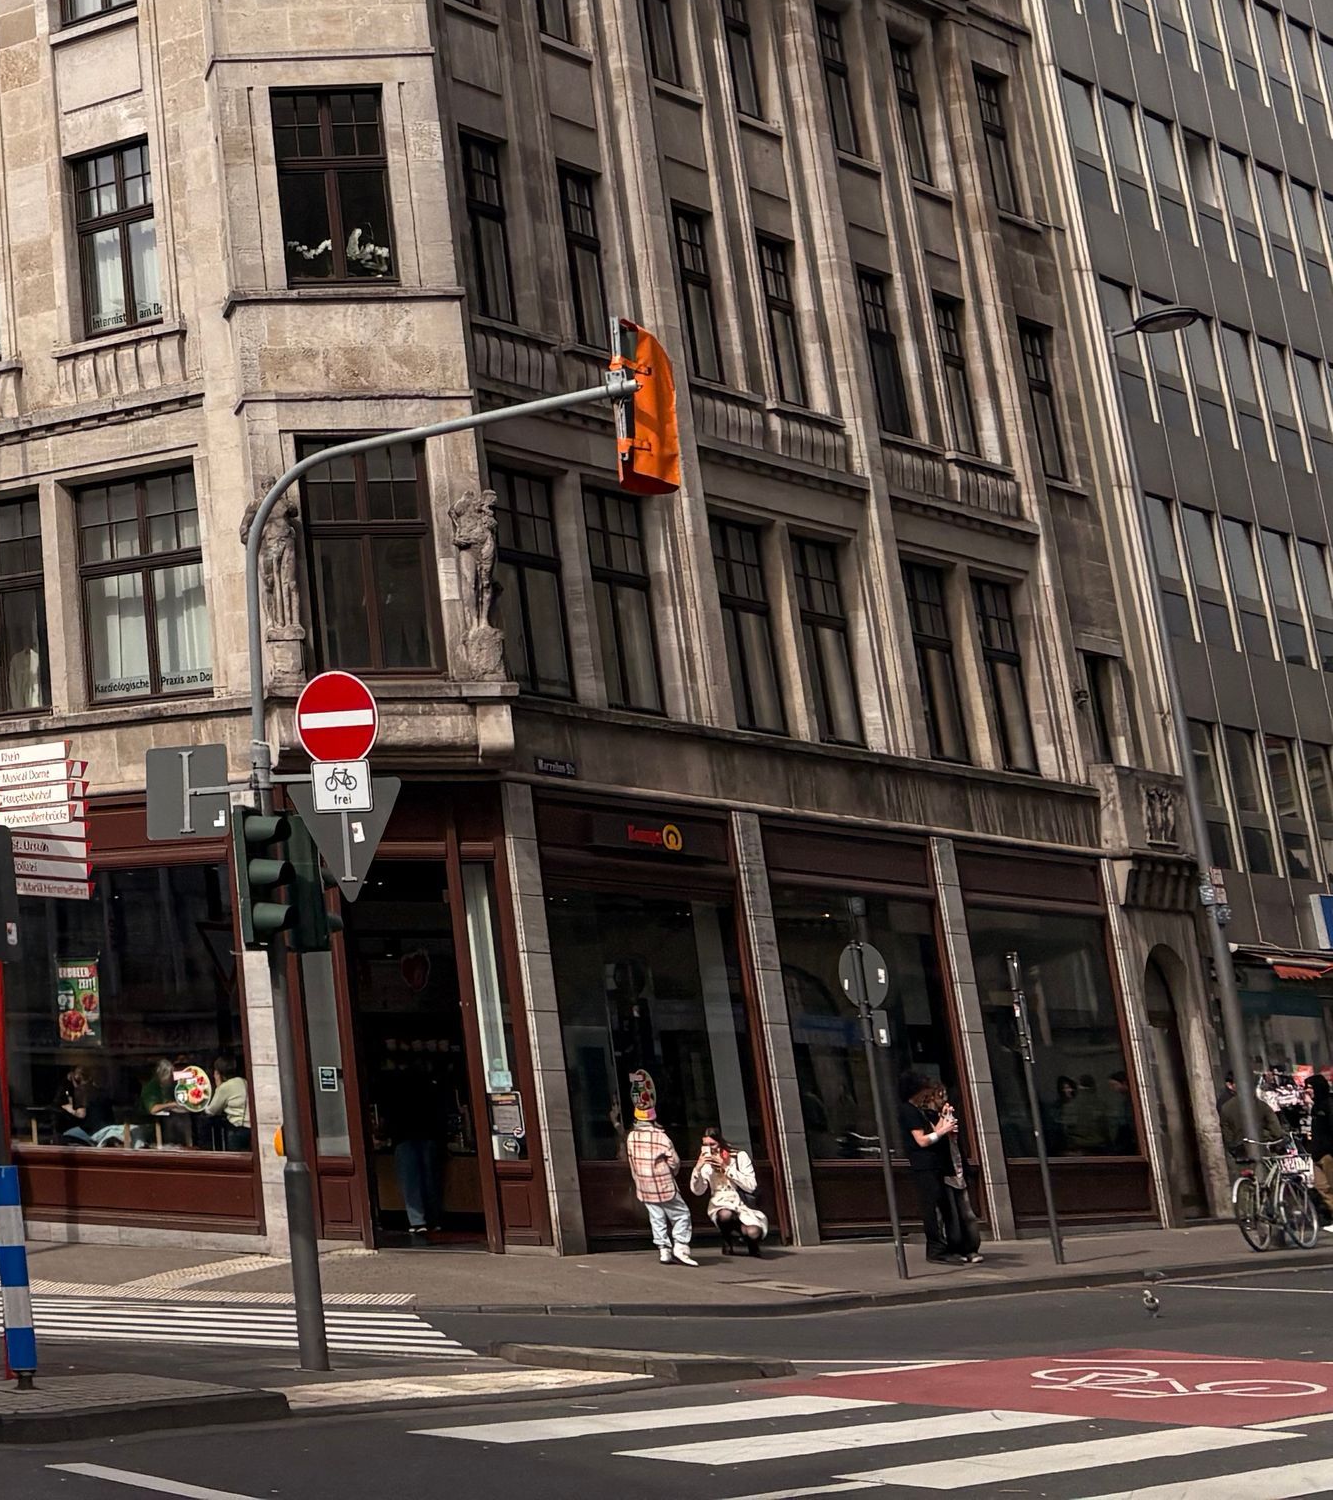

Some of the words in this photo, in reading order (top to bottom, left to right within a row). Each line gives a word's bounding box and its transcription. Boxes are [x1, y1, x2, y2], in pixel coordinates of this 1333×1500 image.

[94, 679, 149, 694] Kardiologische
[161, 676, 185, 687] Praxis
[186, 674, 199, 684] am
[334, 794, 352, 805] frei
[15, 861, 38, 872] olizei
